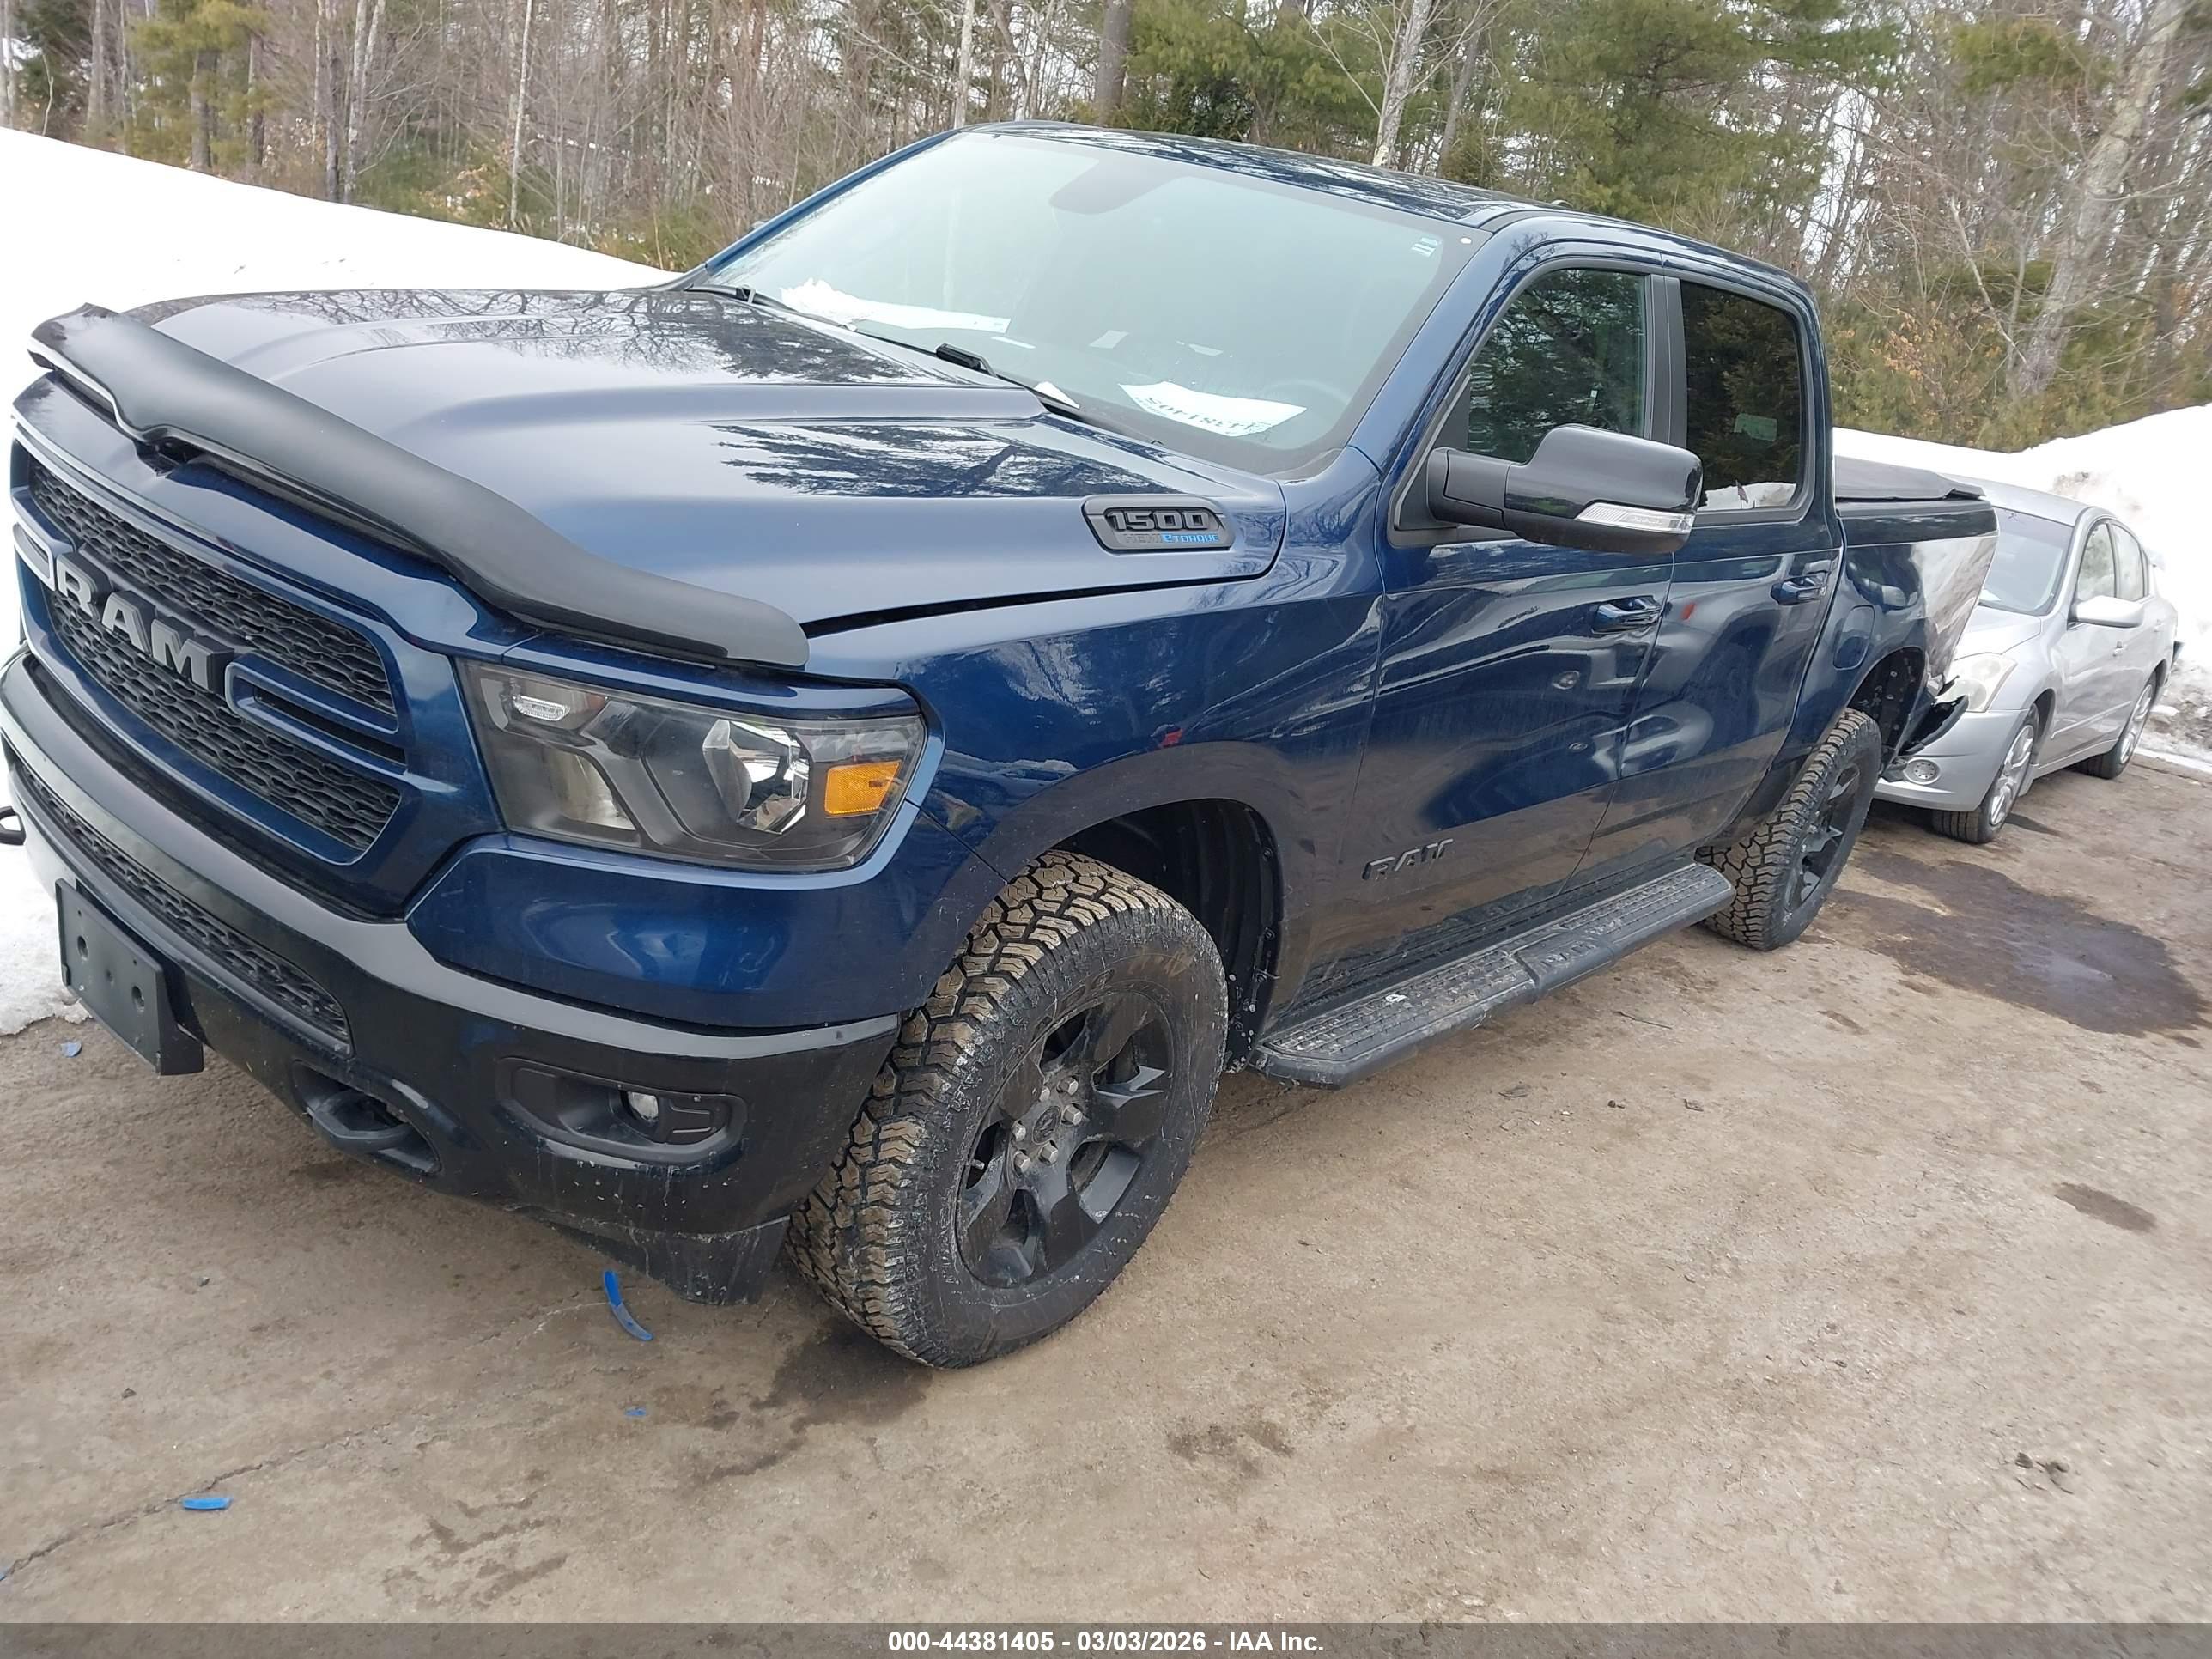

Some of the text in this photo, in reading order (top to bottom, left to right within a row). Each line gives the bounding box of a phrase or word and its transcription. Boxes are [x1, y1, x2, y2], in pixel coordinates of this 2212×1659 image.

[1107, 509, 1209, 531] 1500
[56, 552, 232, 691] RAM
[1362, 838, 1454, 880] RAM
